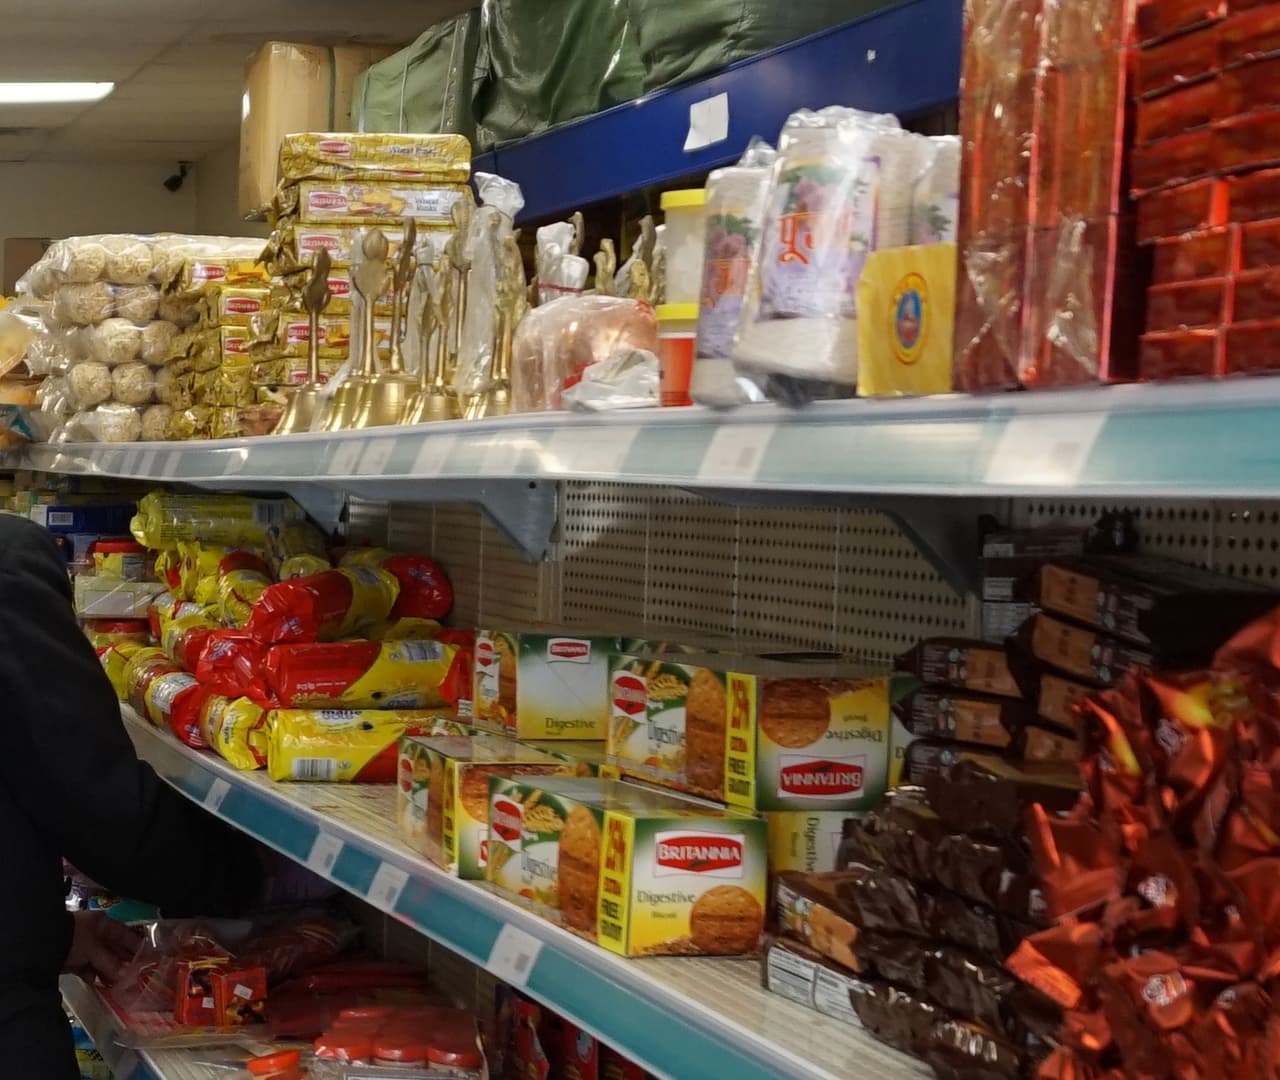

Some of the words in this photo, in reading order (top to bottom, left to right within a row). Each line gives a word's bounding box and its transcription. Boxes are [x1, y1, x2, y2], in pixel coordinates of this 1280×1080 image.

[545, 717, 596, 730] Digestive
[783, 770, 862, 787] BRITANNIA
[659, 844, 740, 863] BRITANNIA
[637, 888, 696, 904] Digestive
